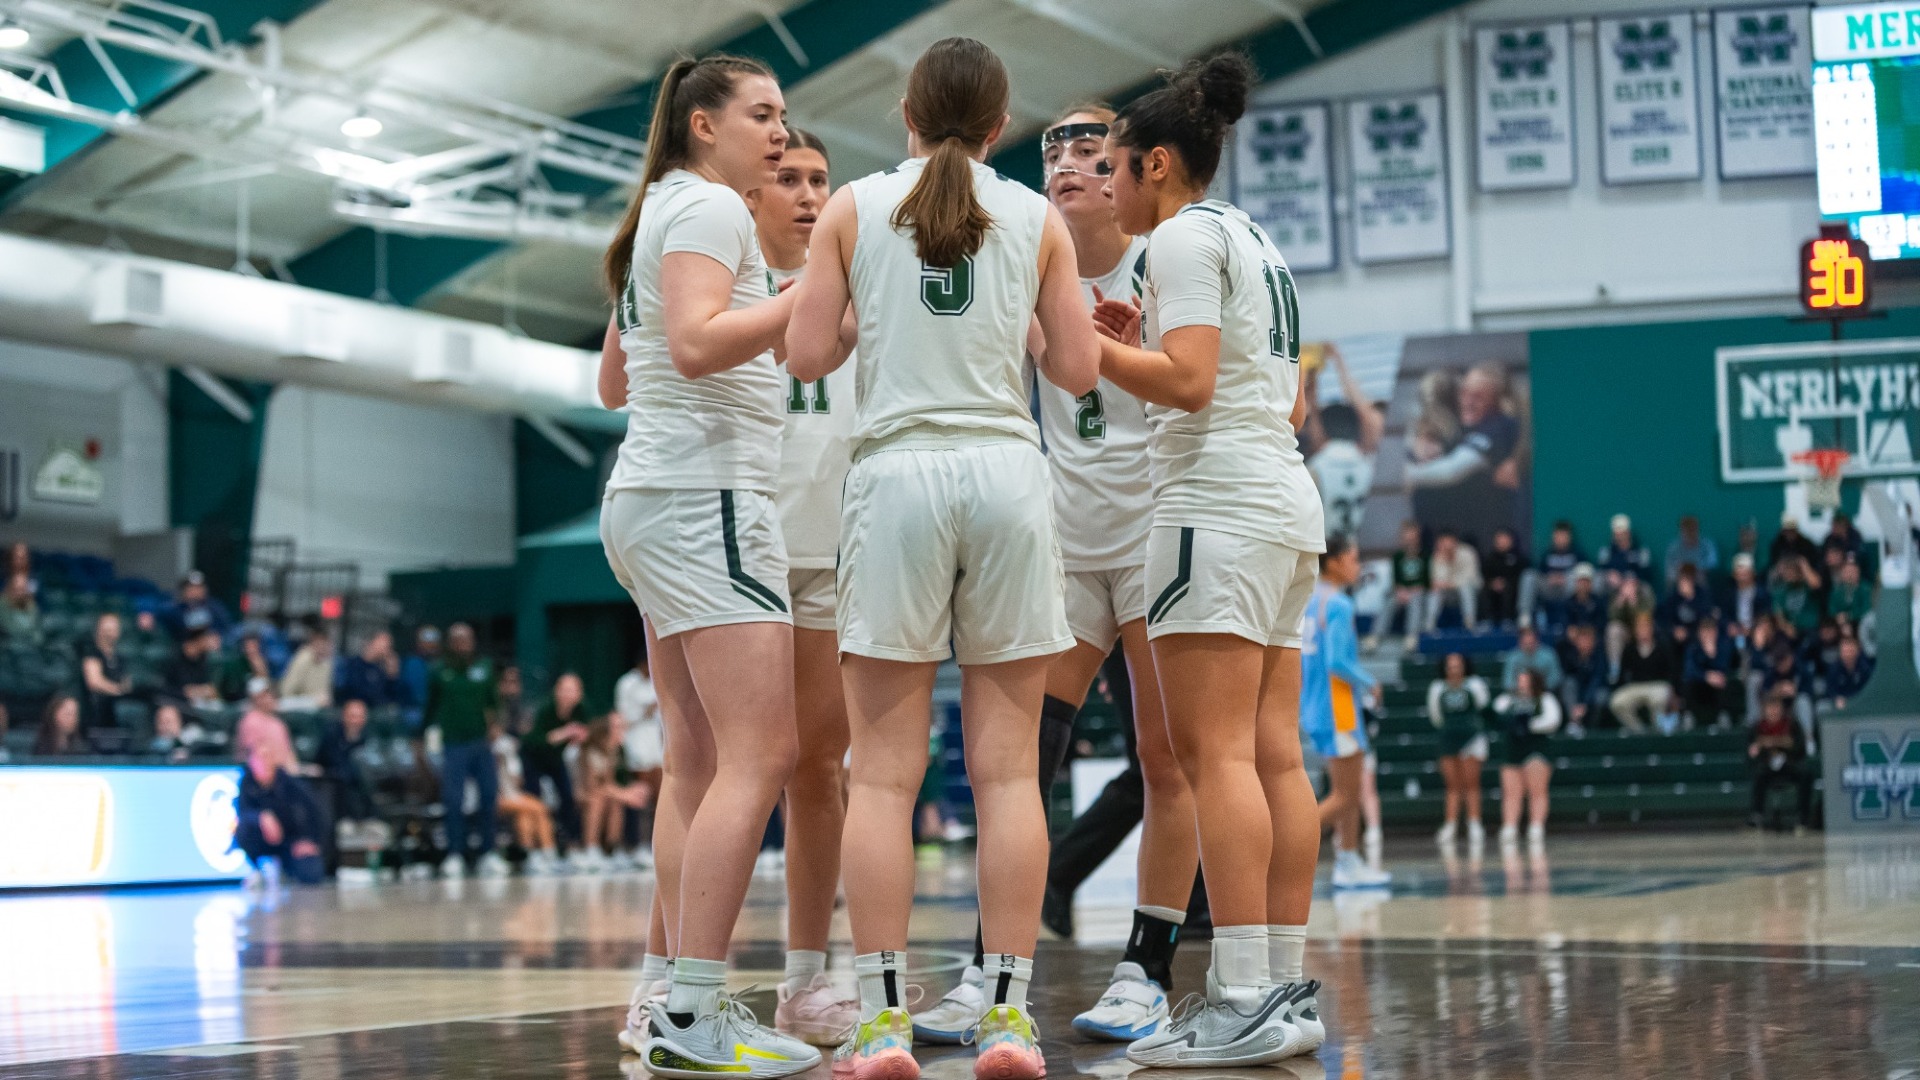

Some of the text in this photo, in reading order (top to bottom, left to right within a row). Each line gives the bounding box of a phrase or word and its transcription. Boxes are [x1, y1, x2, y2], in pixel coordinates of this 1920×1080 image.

[1846, 10, 1920, 50] MER
[1489, 88, 1540, 110] ELITE
[1613, 81, 1665, 102] ELITE
[1809, 256, 1864, 308] 30
[1262, 260, 1300, 364] 10
[1075, 386, 1106, 441] 2
